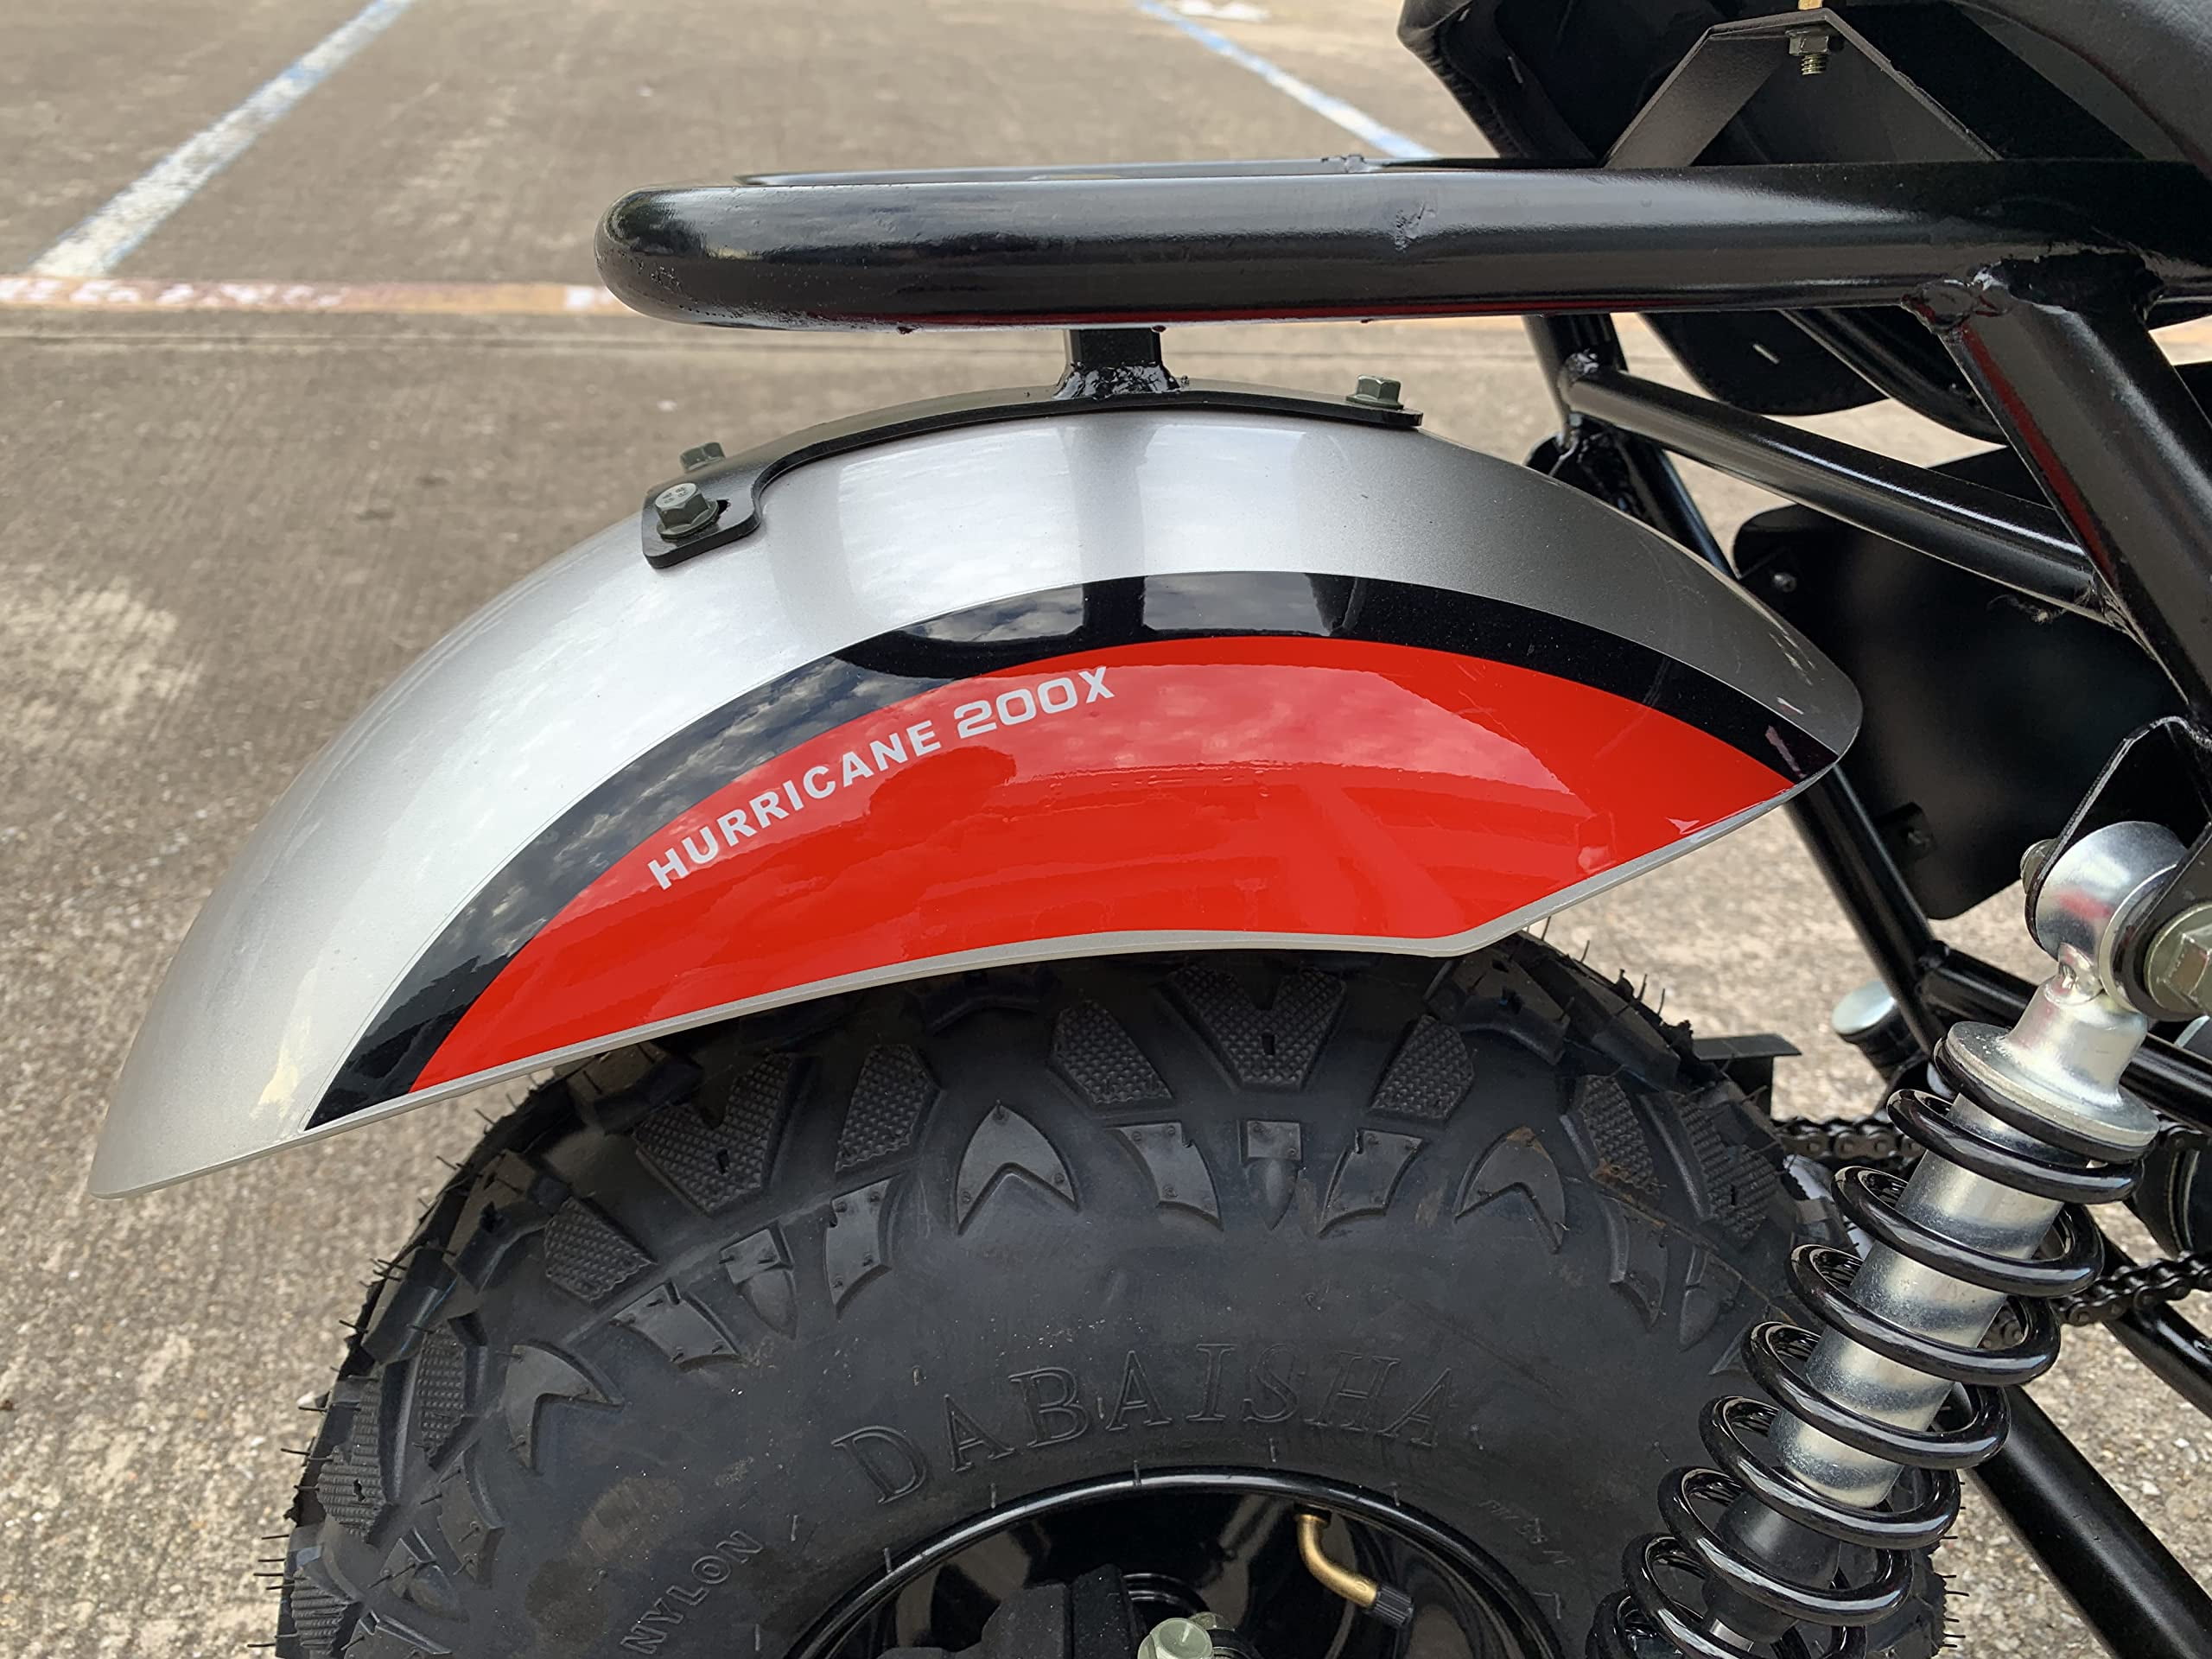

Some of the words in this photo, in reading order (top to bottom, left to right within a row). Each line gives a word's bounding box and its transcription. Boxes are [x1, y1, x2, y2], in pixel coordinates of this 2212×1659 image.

[647, 720, 941, 890] HURRICANE
[953, 666, 1115, 740] 200X
[830, 1341, 1453, 1504] DABAISHA
[620, 1529, 764, 1655] NYLON
